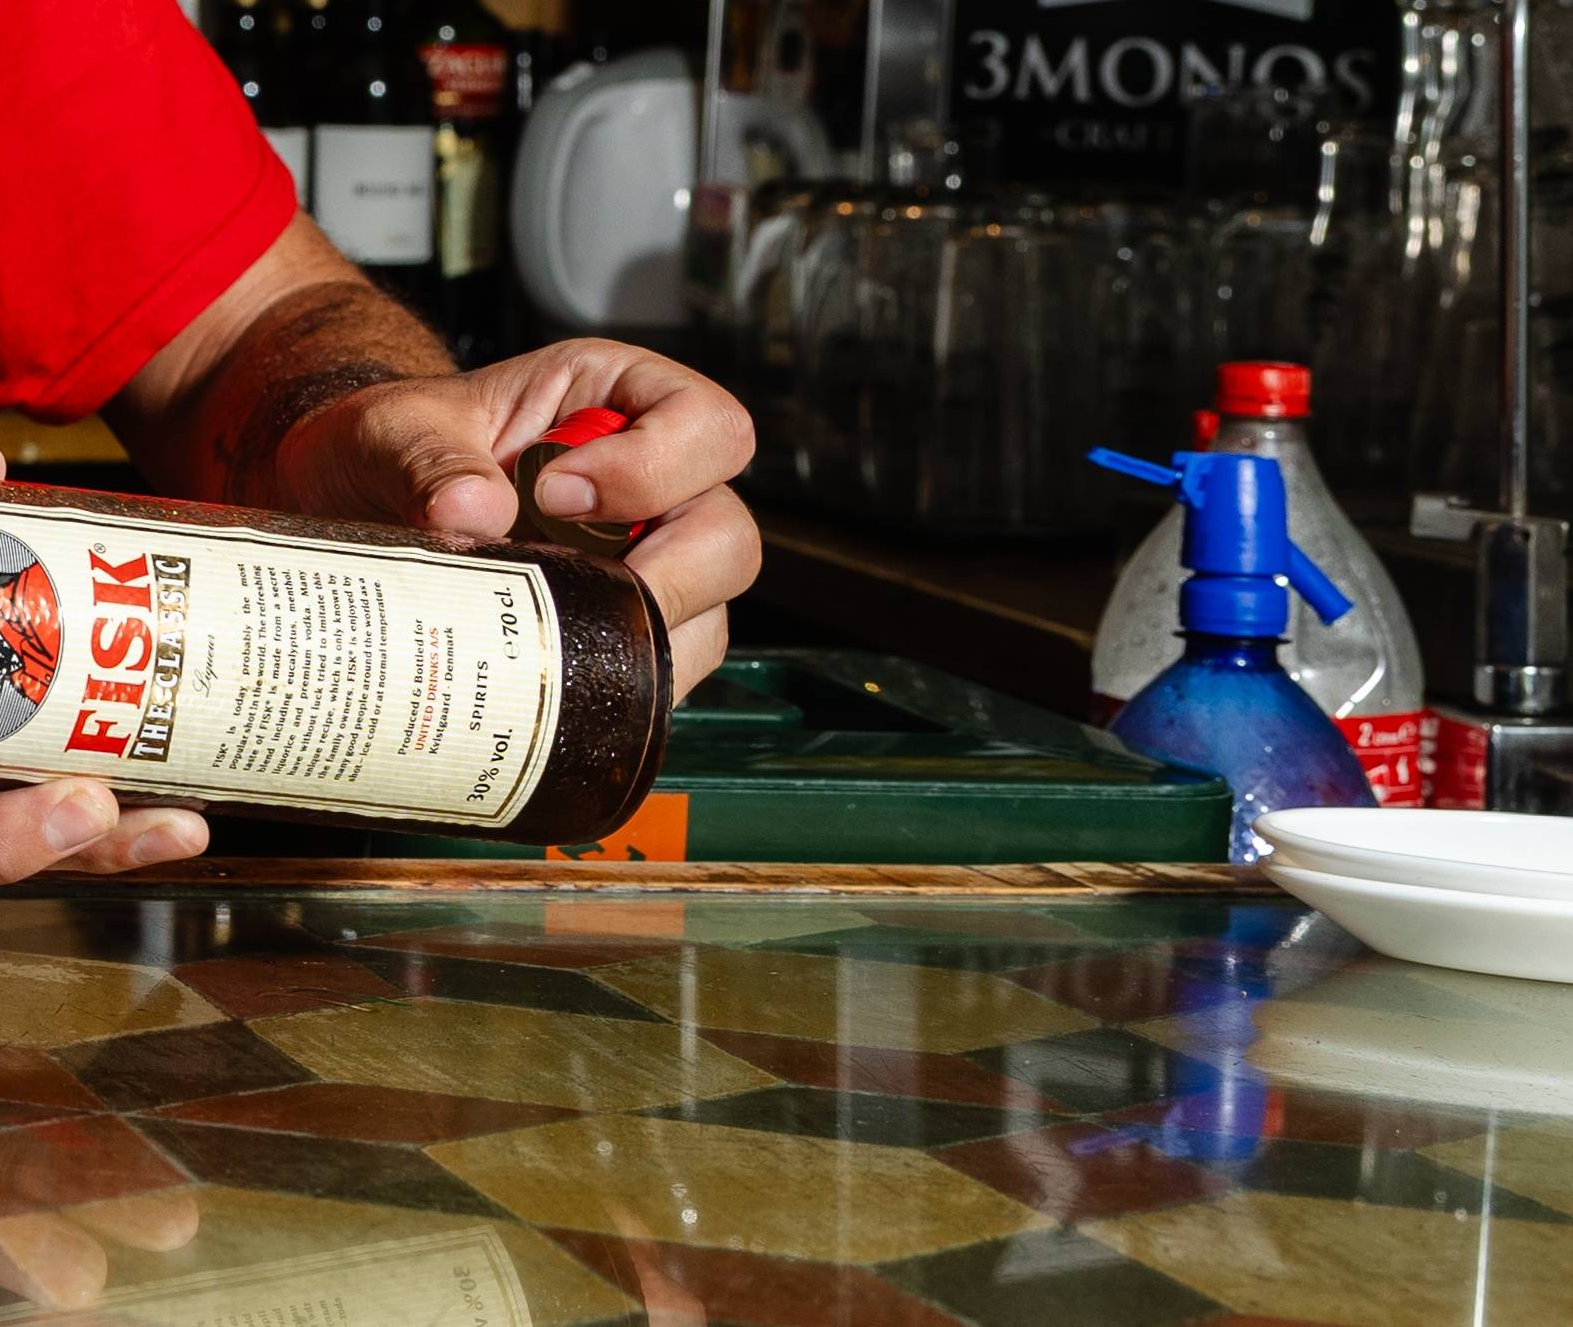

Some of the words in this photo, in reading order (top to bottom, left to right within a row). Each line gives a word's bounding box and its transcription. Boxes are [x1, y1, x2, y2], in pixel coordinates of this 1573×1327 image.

[236, 563, 248, 586] most
[266, 566, 279, 597] secret
[298, 569, 309, 596] Many
[312, 571, 322, 589] this
[327, 573, 337, 584] by
[342, 575, 352, 586] by
[252, 564, 266, 617] refreshing
[359, 585, 367, 596] as
[241, 596, 250, 614] the
[317, 594, 327, 632] imitate
[331, 589, 341, 623] known
[343, 590, 356, 631] enjoyed
[359, 598, 371, 627] world
[257, 619, 266, 638] The
[273, 615, 281, 641] from
[413, 618, 423, 635] for
[501, 611, 519, 639] 70
[241, 624, 253, 675] probably
[319, 637, 327, 648] to
[333, 628, 343, 651] only
[348, 636, 357, 645] is
[363, 630, 372, 647] the
[133, 704, 172, 757] THE
[156, 557, 188, 689] CLASSIC
[256, 643, 266, 677] world.
[271, 648, 281, 679] made
[316, 654, 326, 681] tried
[332, 656, 341, 665] is
[378, 648, 387, 688] normal
[413, 638, 424, 683] Bottled
[299, 649, 311, 699] premium
[362, 650, 372, 691] around
[251, 679, 263, 697] the
[267, 685, 277, 694] is
[310, 687, 323, 710] luck
[328, 670, 340, 702] which
[376, 690, 384, 701] at
[412, 687, 422, 697] &
[428, 692, 451, 754] Kvistgaard
[443, 627, 454, 681] Denmark
[469, 659, 489, 732] SPIRITS
[232, 685, 249, 716] today
[248, 699, 259, 710] in
[353, 692, 368, 730] people
[373, 703, 381, 715] or
[414, 705, 434, 750] UNITED
[426, 652, 438, 701] DRINKS
[225, 725, 236, 734] is
[242, 712, 256, 733] shot
[292, 707, 303, 727] and
[366, 717, 378, 740] cold
[396, 700, 419, 755] Produced
[255, 747, 275, 772] blend
[270, 692, 293, 741] including
[255, 734, 265, 745] of
[299, 714, 317, 752] without
[344, 732, 359, 757] good
[228, 735, 248, 769] popular
[324, 732, 344, 762] family
[358, 741, 371, 756] ice
[491, 727, 513, 763] vol.
[242, 749, 259, 771] taste
[285, 755, 303, 775] have
[303, 747, 323, 777] unique
[317, 764, 331, 778] the
[333, 757, 351, 780] many
[347, 764, 362, 782] shot
[466, 767, 500, 803] 30%
